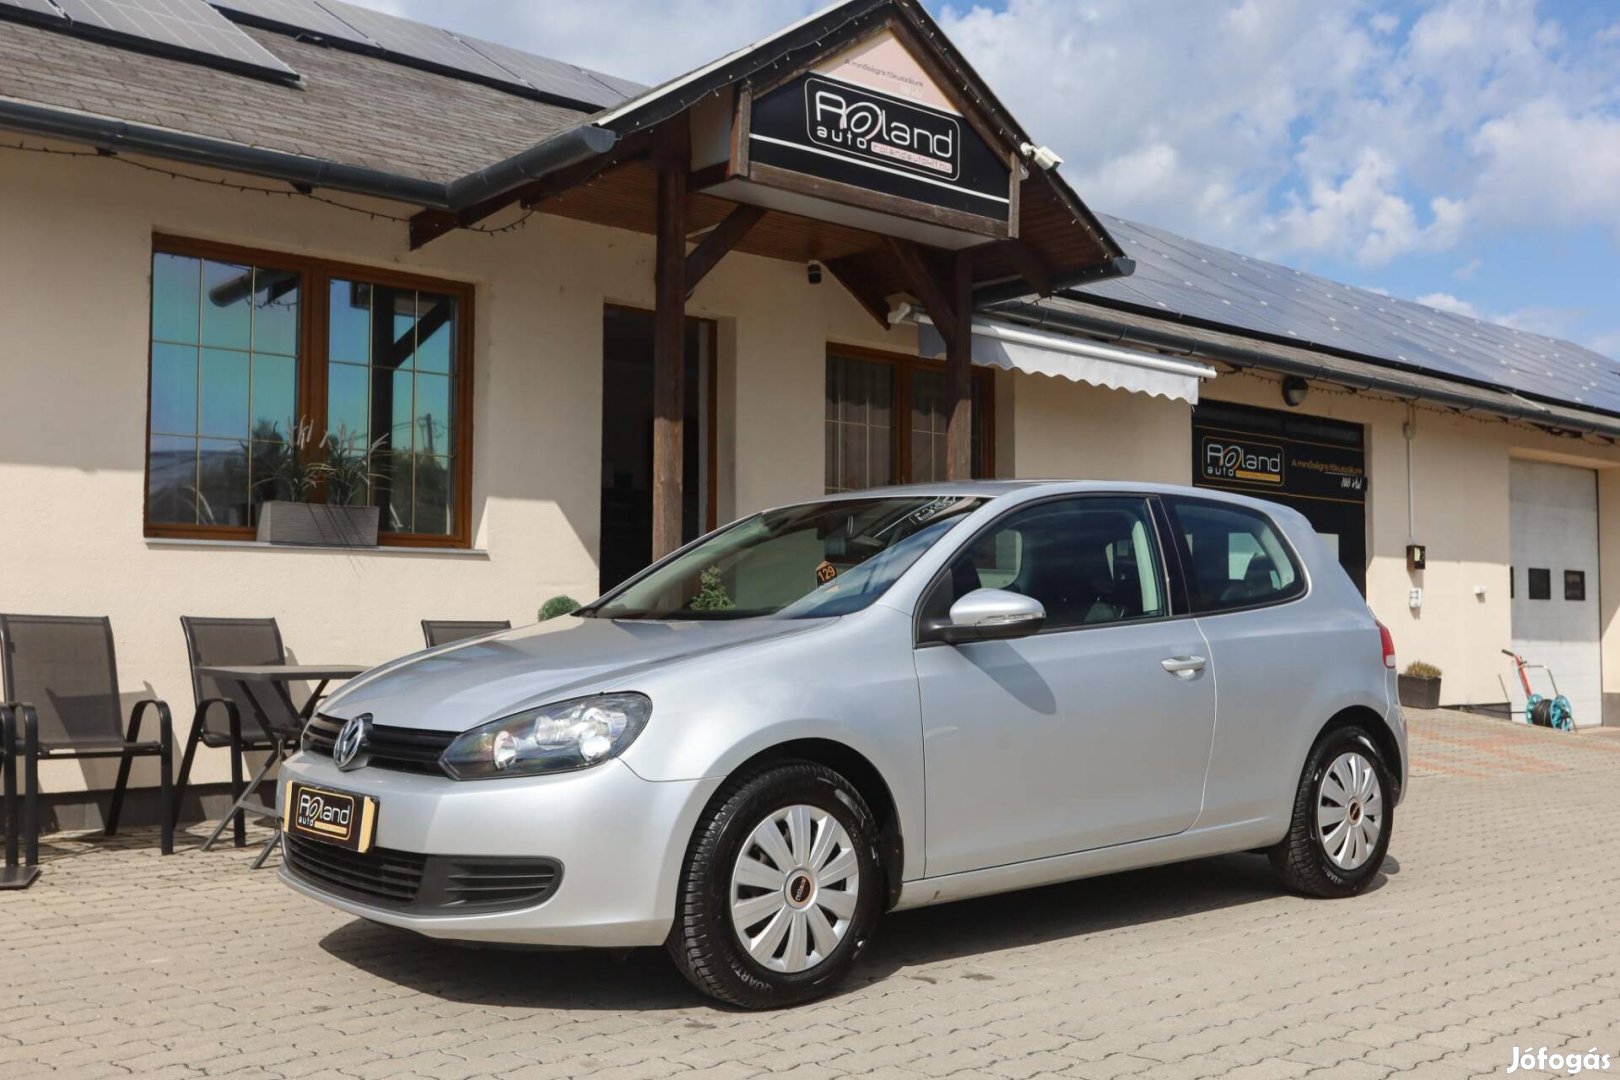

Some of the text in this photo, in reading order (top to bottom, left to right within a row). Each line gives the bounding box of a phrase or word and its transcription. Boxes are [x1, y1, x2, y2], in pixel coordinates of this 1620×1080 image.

[815, 91, 953, 158] Roland
[816, 126, 867, 149] auto
[1207, 443, 1281, 473] Roland
[1207, 466, 1235, 478] auto
[817, 566, 836, 582] 129
[300, 793, 351, 825] Roland
[298, 815, 314, 827] auto
